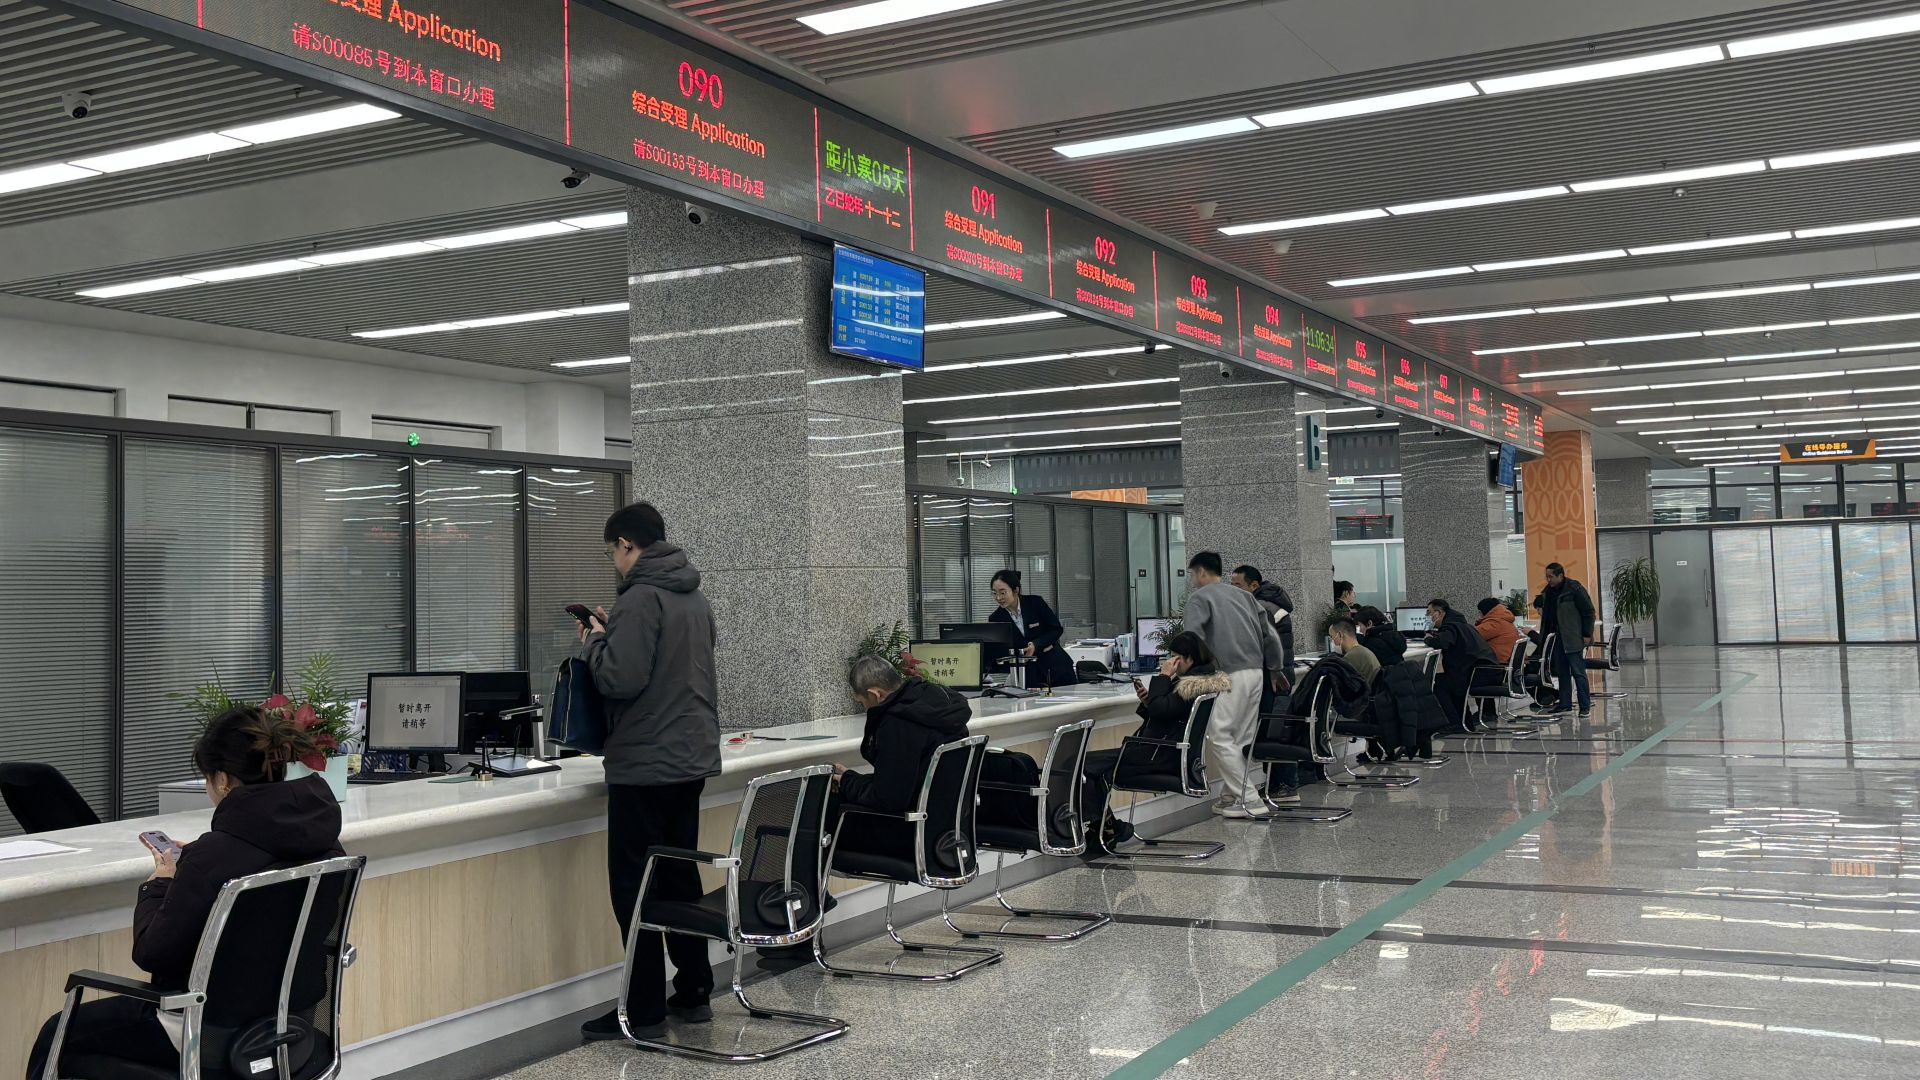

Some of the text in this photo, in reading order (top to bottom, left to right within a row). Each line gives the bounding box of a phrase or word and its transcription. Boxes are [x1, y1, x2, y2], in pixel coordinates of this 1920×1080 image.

[388, 0, 502, 62] Application
[291, 22, 496, 110] 请S00085号到本窗口办理
[678, 61, 724, 109] 090
[632, 90, 766, 158] 综合受理 Application
[633, 138, 766, 199] 请S00133号到本窗口办理
[825, 140, 905, 197] 距小寒05天
[971, 185, 997, 219] 091
[944, 210, 1023, 254] 综合受理 Application
[1095, 236, 1116, 265] 092
[1102, 268, 1135, 294] Application
[1191, 275, 1208, 299] 093
[1265, 304, 1280, 326] 094
[930, 657, 959, 665] 暂时离开
[934, 668, 955, 677] 请稍等
[398, 702, 432, 713] 暂时离开
[402, 718, 427, 729] 请稍等
